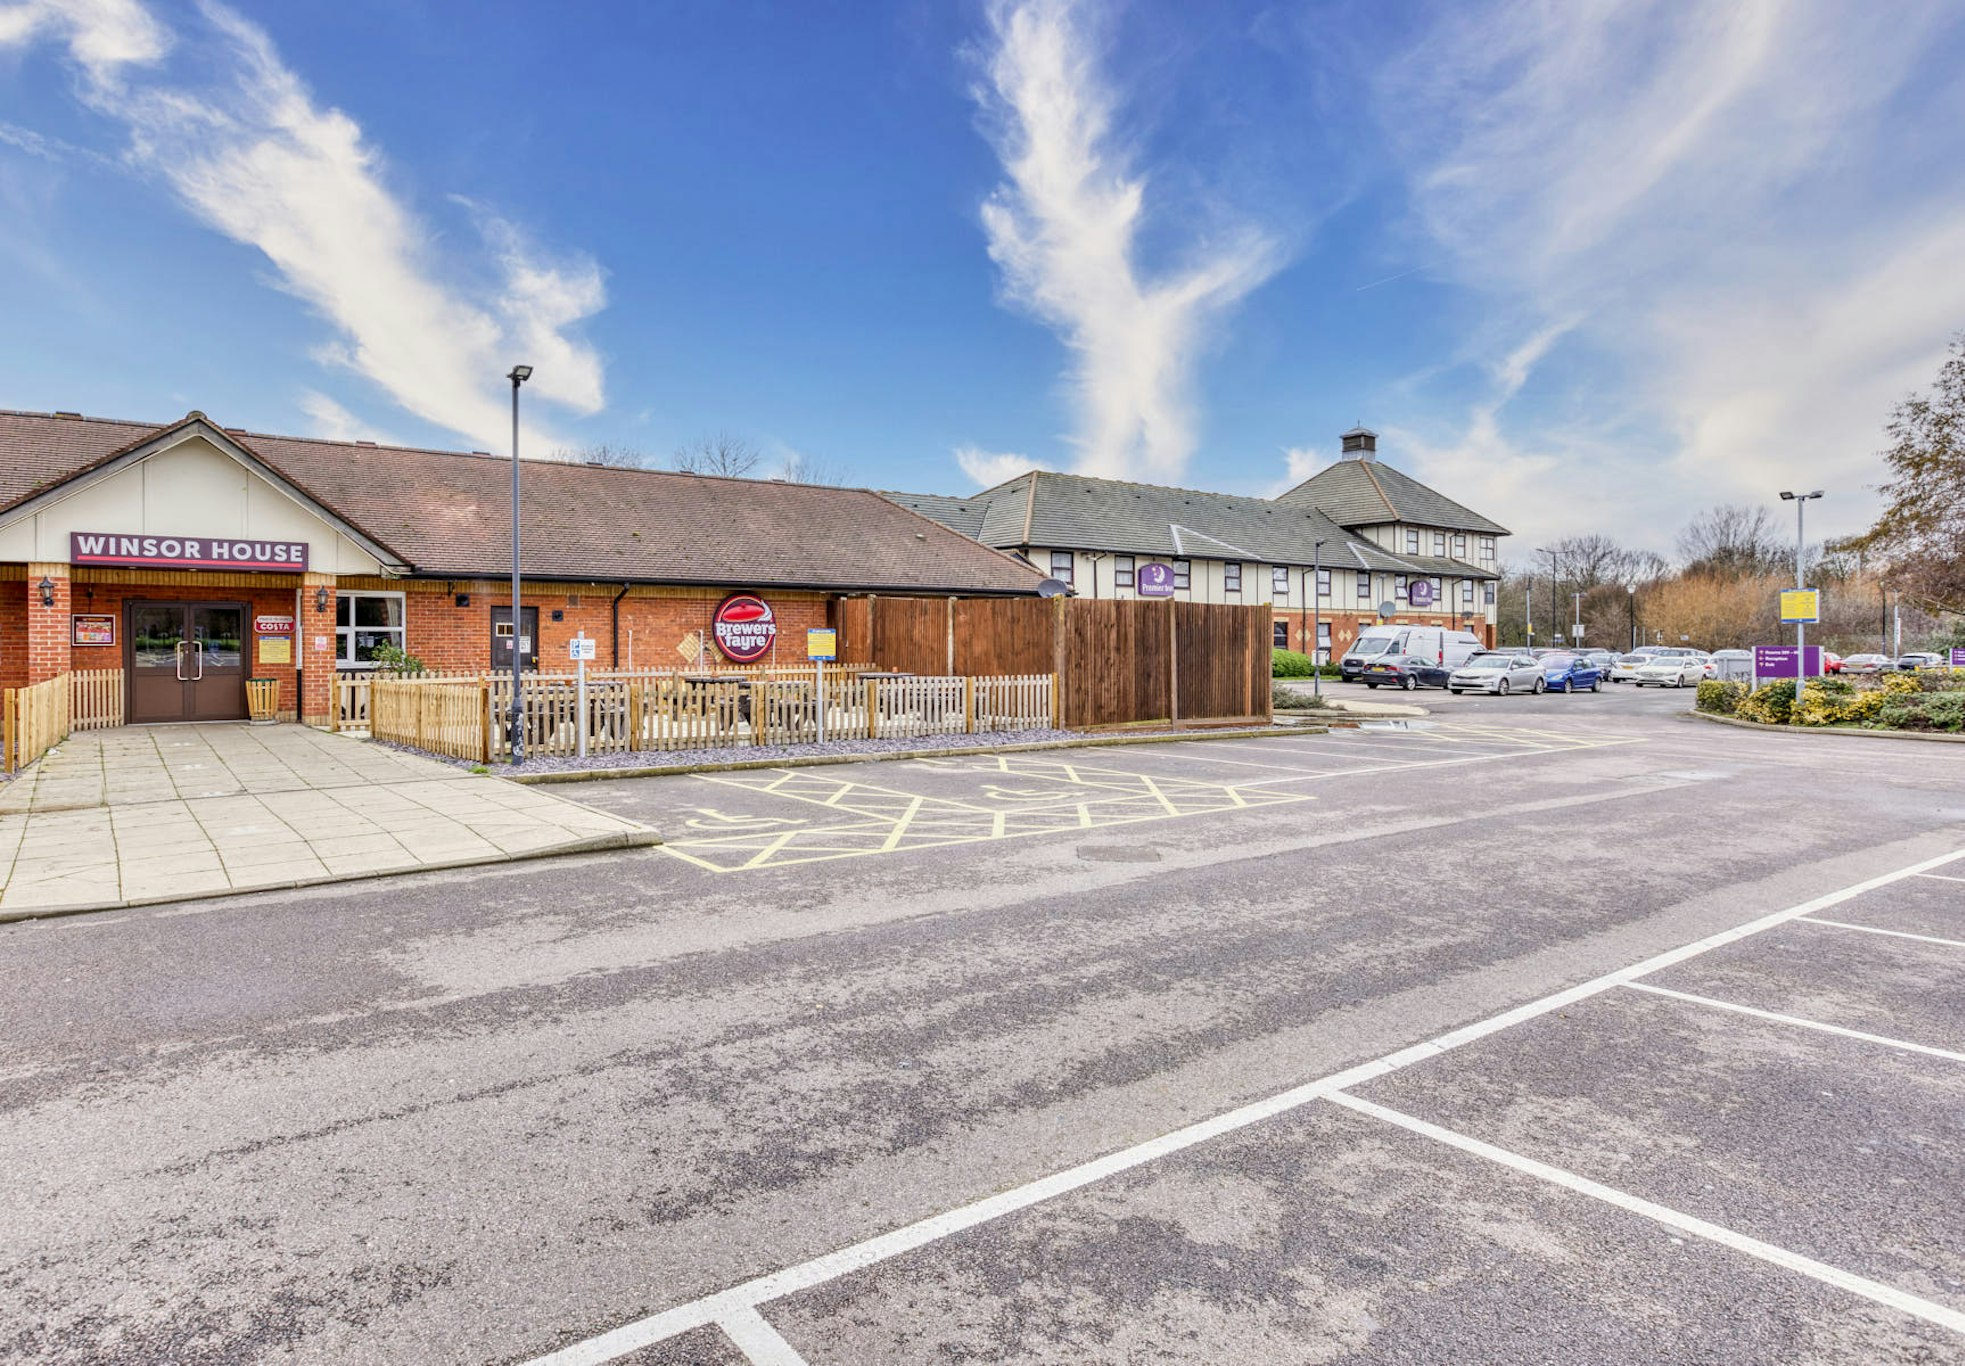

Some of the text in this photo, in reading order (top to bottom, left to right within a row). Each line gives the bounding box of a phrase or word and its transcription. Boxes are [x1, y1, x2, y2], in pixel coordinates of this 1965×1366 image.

[77, 535, 303, 562] WINSOR HOUSE
[1142, 583, 1165, 592] Premier
[260, 623, 290, 631] COSTA
[715, 622, 777, 637] Brewers
[725, 633, 766, 651] fayre
